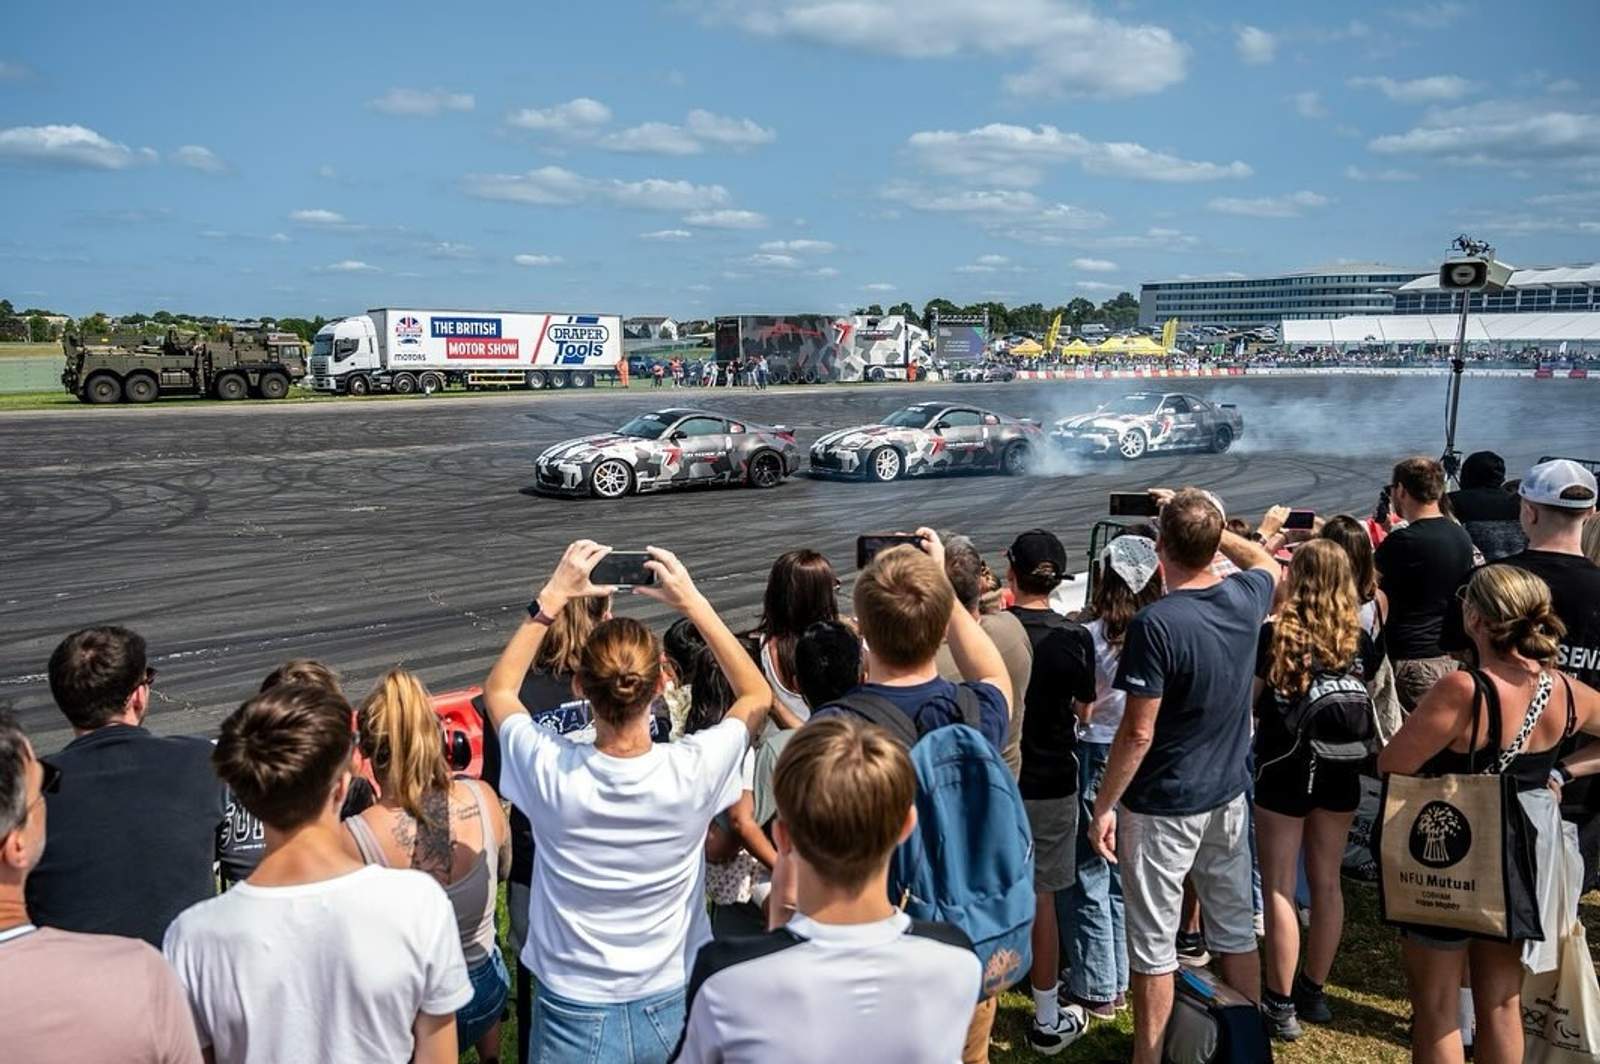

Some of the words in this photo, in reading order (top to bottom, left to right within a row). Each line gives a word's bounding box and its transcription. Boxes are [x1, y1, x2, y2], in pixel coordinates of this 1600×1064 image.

[433, 321, 454, 335] THE
[456, 321, 497, 336] BRITISH
[554, 328, 603, 340] DRAPER
[448, 342, 486, 355] MOTOR
[487, 343, 517, 356] SHOW
[556, 340, 604, 357] Tools
[1399, 871, 1424, 886] NFU
[1426, 874, 1476, 892] Mutual
